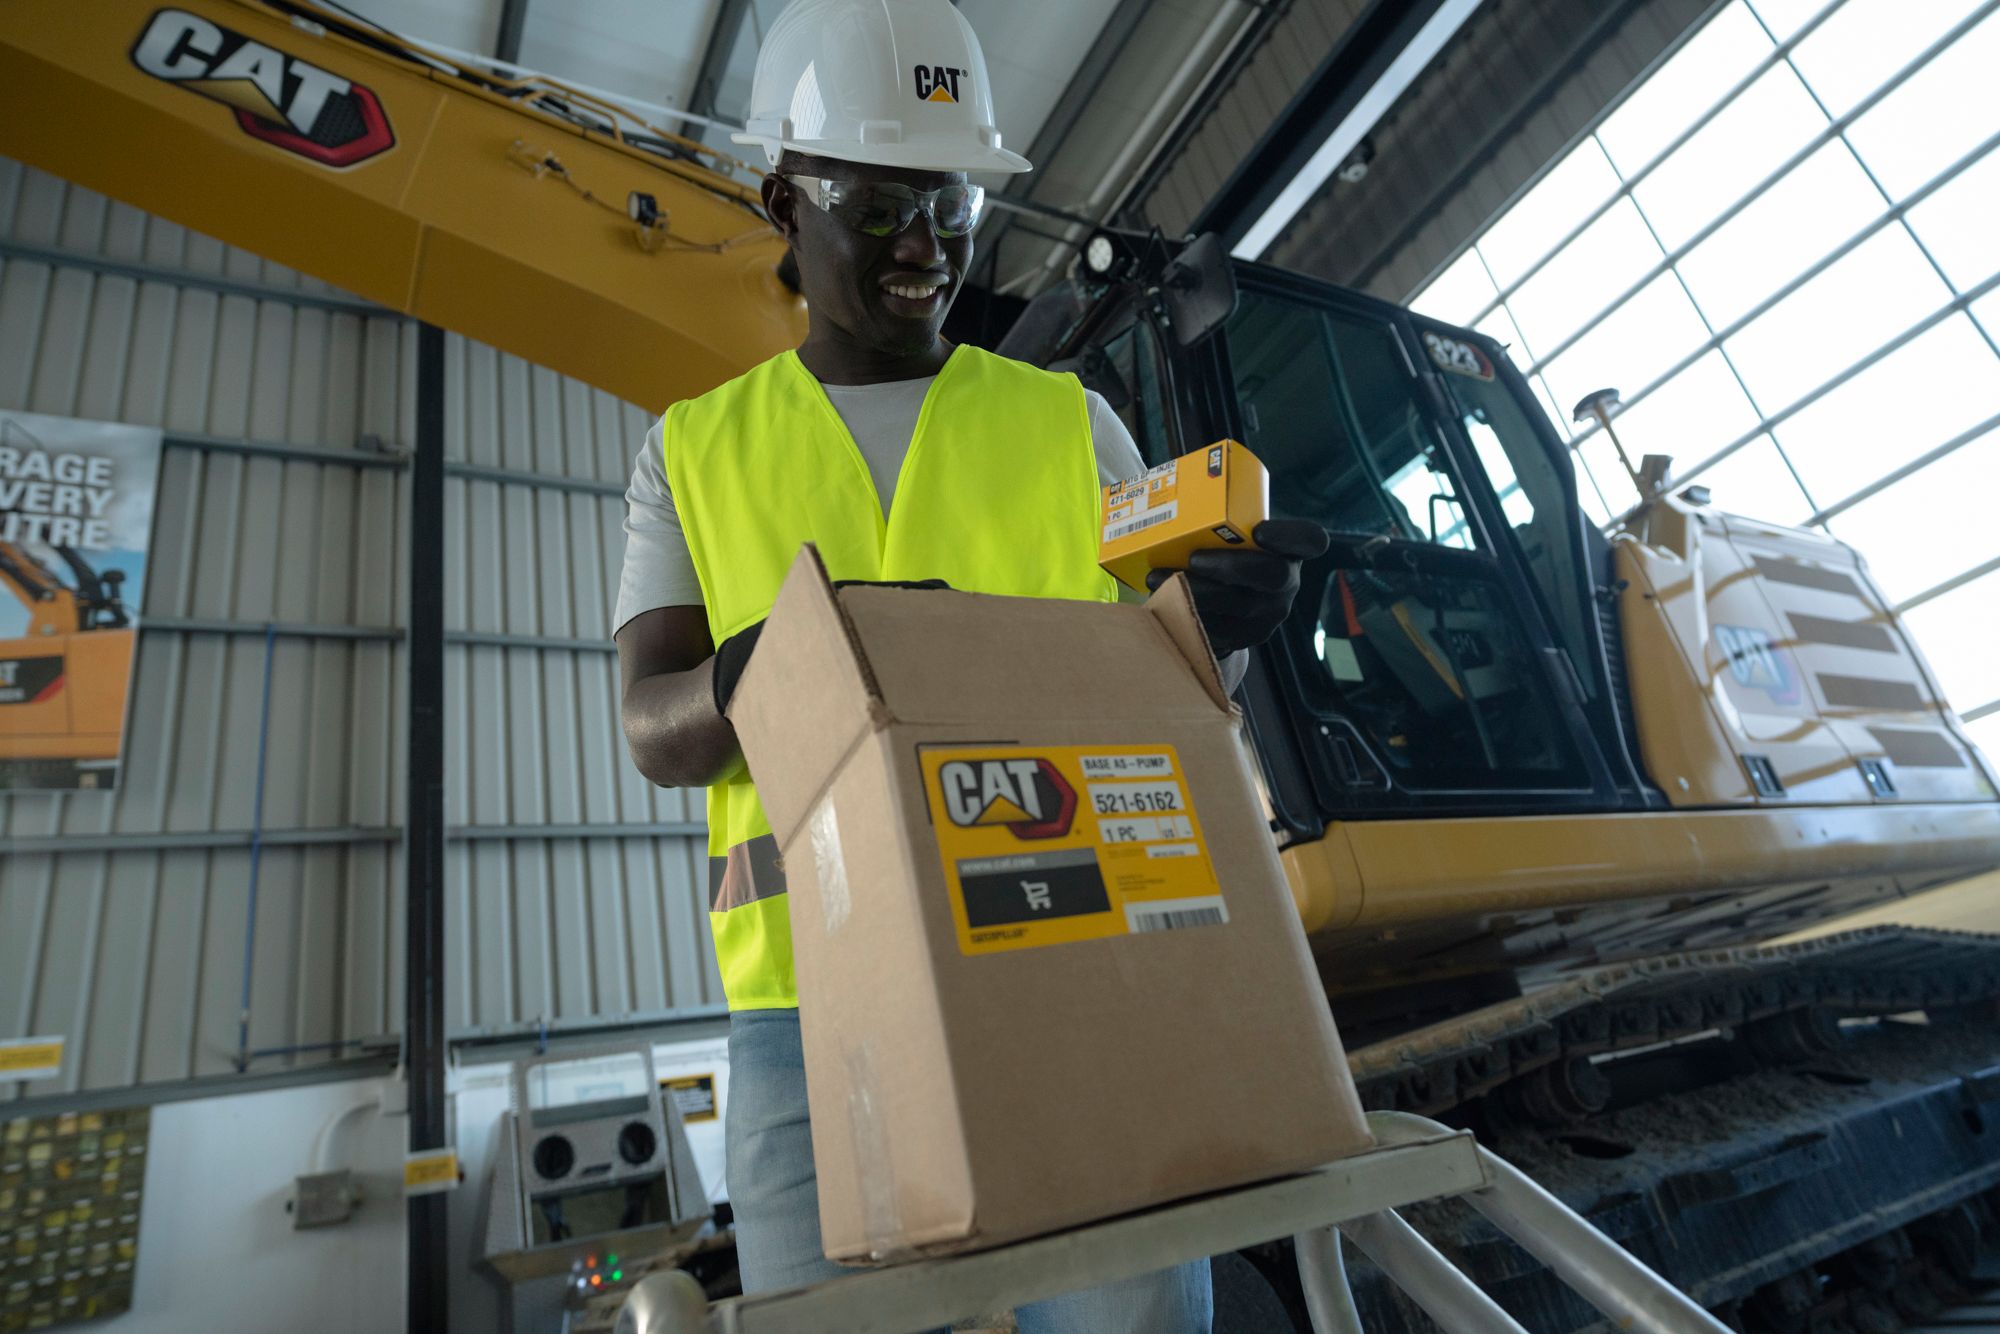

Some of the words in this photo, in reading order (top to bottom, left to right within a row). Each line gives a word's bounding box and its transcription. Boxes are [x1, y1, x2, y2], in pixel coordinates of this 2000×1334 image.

[134, 8, 352, 135] CAT
[1425, 333, 1481, 375] 323
[1209, 449, 1221, 469] CAT
[0, 511, 111, 551] ITRE
[1215, 527, 1238, 540] CAT
[1713, 624, 1785, 689] CAT
[1084, 757, 1111, 770] BASE
[941, 761, 1043, 826] CAT
[1095, 791, 1177, 814] 521-6162
[1105, 828, 1115, 843] 1
[1117, 825, 1137, 841] PC
